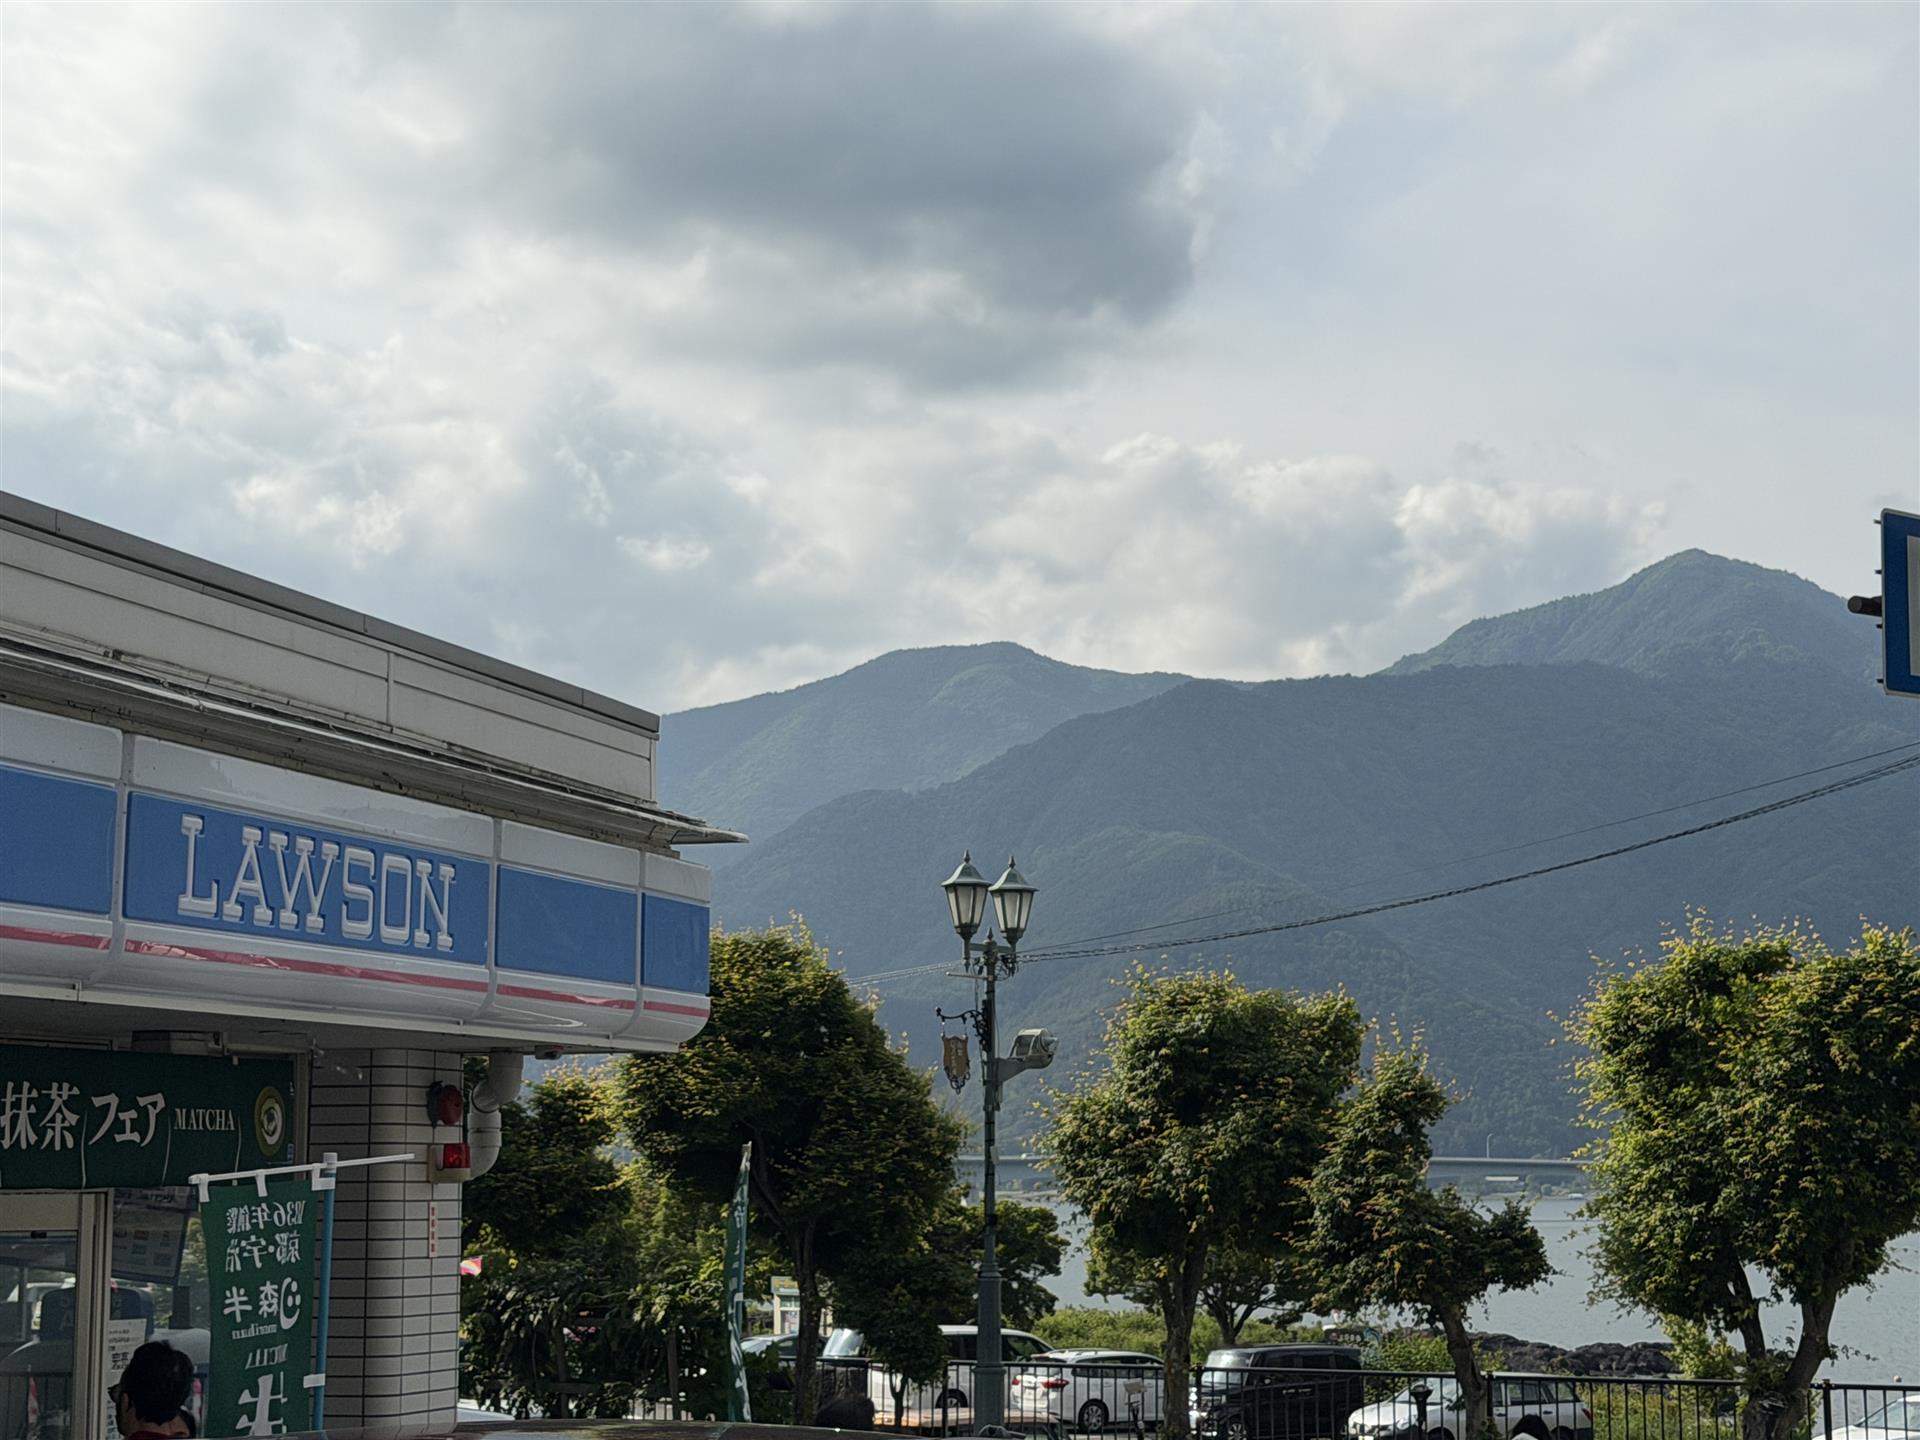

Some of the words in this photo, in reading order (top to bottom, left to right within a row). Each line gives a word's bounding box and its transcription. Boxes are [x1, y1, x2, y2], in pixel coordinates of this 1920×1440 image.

[179, 814, 455, 950] LAWSON
[0, 1081, 165, 1151] 抹茶フェア
[174, 1108, 236, 1132] MATCHA
